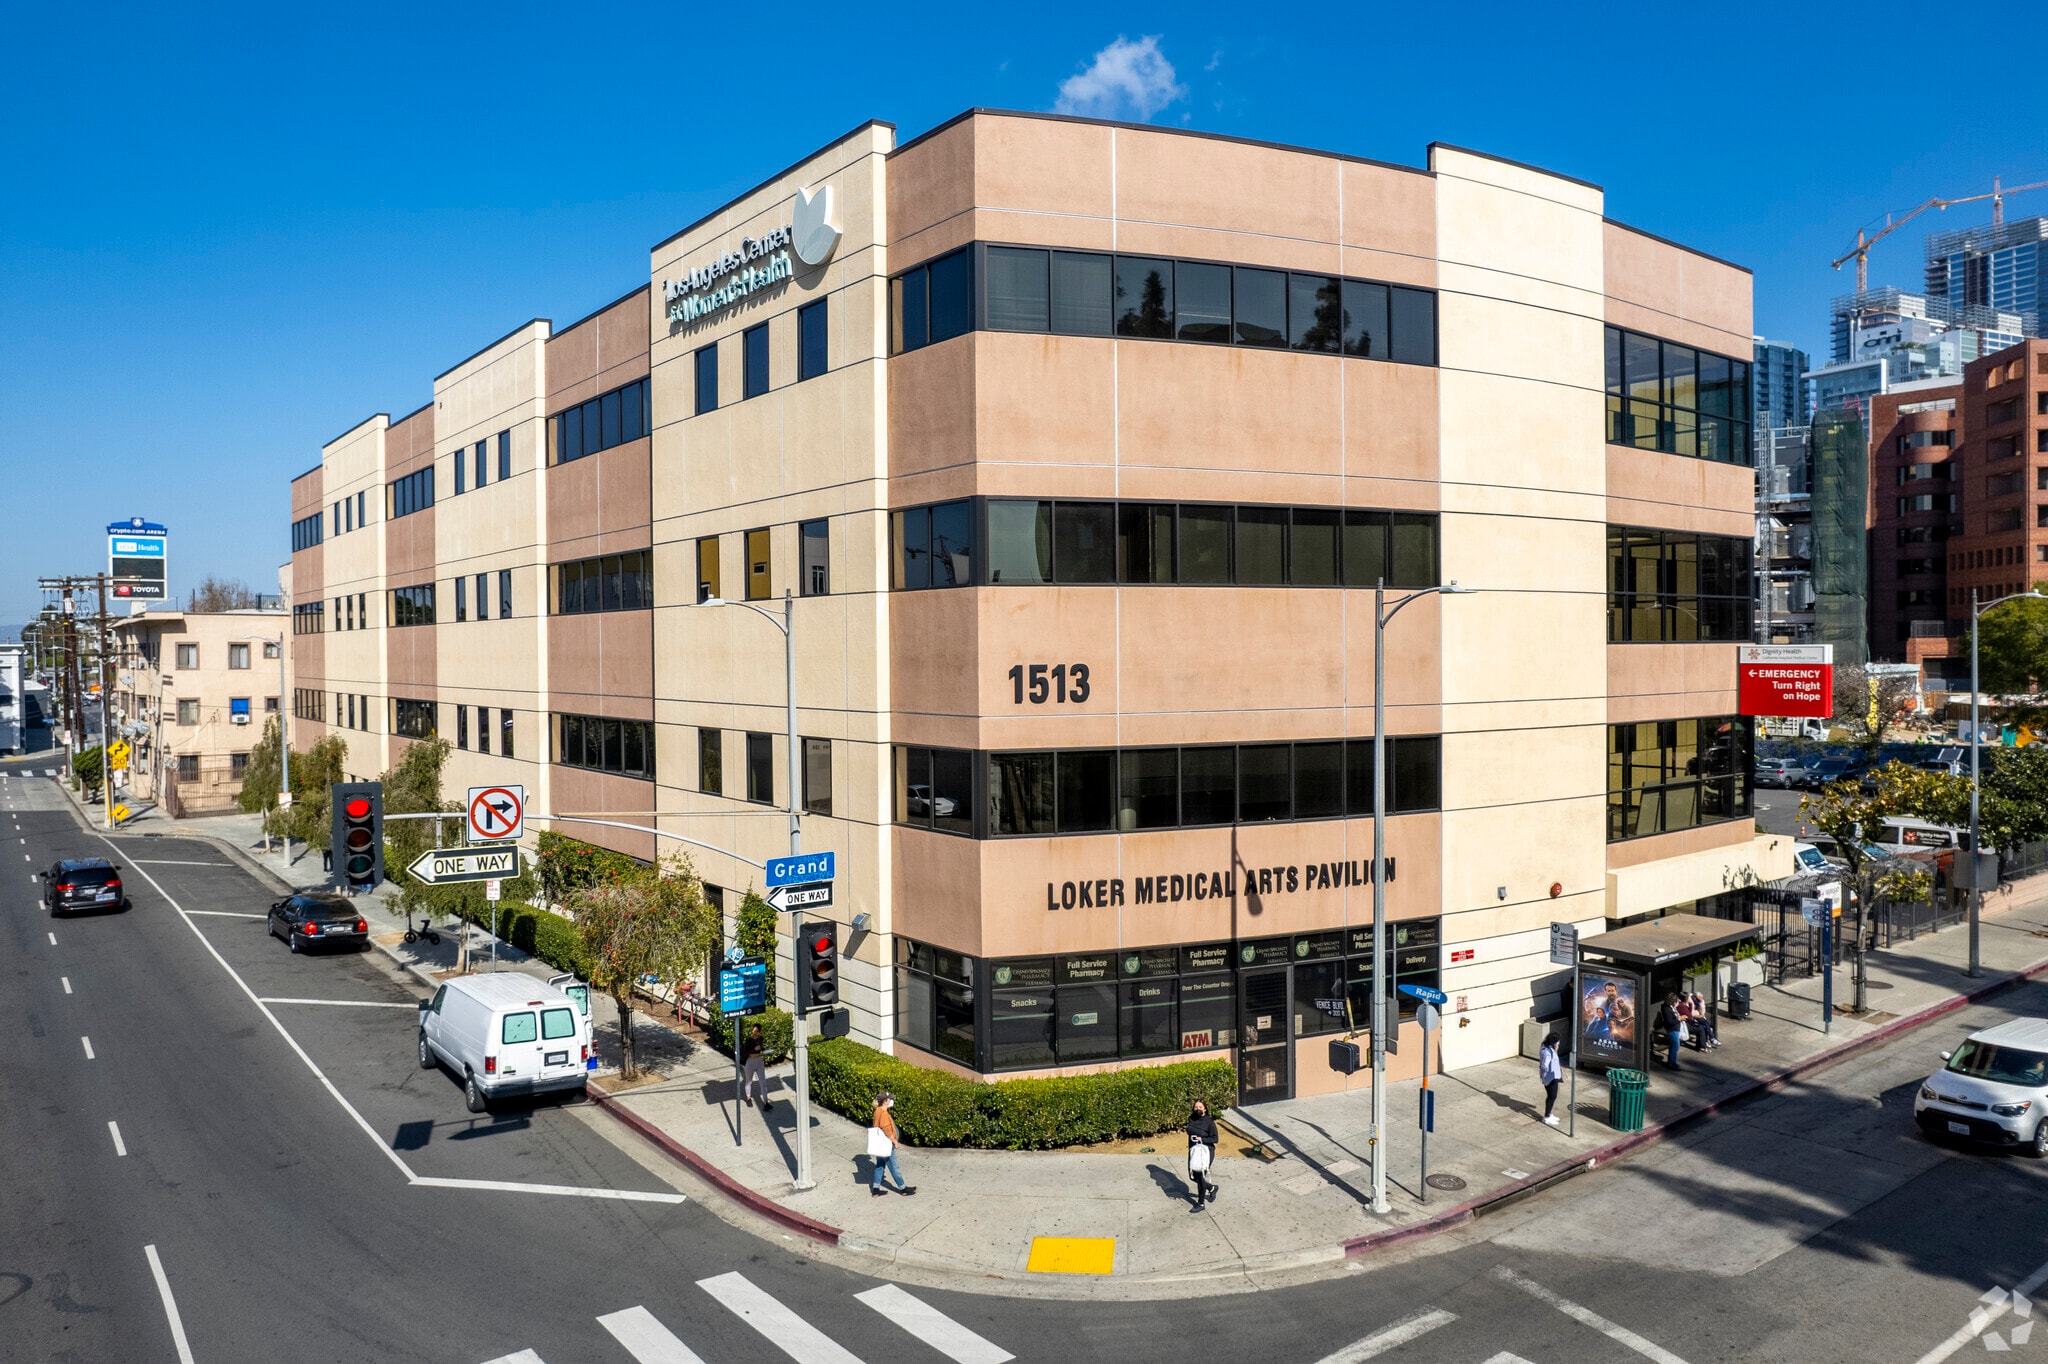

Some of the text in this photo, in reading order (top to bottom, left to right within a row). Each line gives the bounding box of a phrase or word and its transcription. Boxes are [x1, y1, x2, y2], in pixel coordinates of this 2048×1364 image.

[665, 224, 793, 302] Los Angeles Center
[682, 275, 743, 322] Women's
[741, 250, 793, 295] Health
[1762, 648, 1782, 656] Dignity
[1759, 669, 1821, 678] EMERGENCY
[1008, 663, 1090, 704] 1513
[1772, 681, 1821, 691] Turn Right
[1796, 692, 1821, 702] Hope
[434, 855, 509, 875] ONE WAY
[774, 857, 827, 878] Grand
[1047, 878, 1125, 911] LOKER
[1135, 870, 1236, 905] MEDICAL
[1243, 865, 1299, 897] ARTS
[787, 890, 826, 904] ONE WAY
[1190, 949, 1227, 959] Full Service
[1067, 960, 1107, 969] Full Service
[1192, 958, 1224, 967] Pharmacy
[1406, 956, 1427, 964] Delivery
[1359, 963, 1374, 971] Snac
[1070, 968, 1105, 978] Pharmacy
[1139, 988, 1160, 997] Drinks
[1416, 987, 1442, 1000] Rapid
[1011, 999, 1037, 1007] Snacks
[1316, 1000, 1331, 1009] VENICE
[1182, 1033, 1210, 1049] ATM
